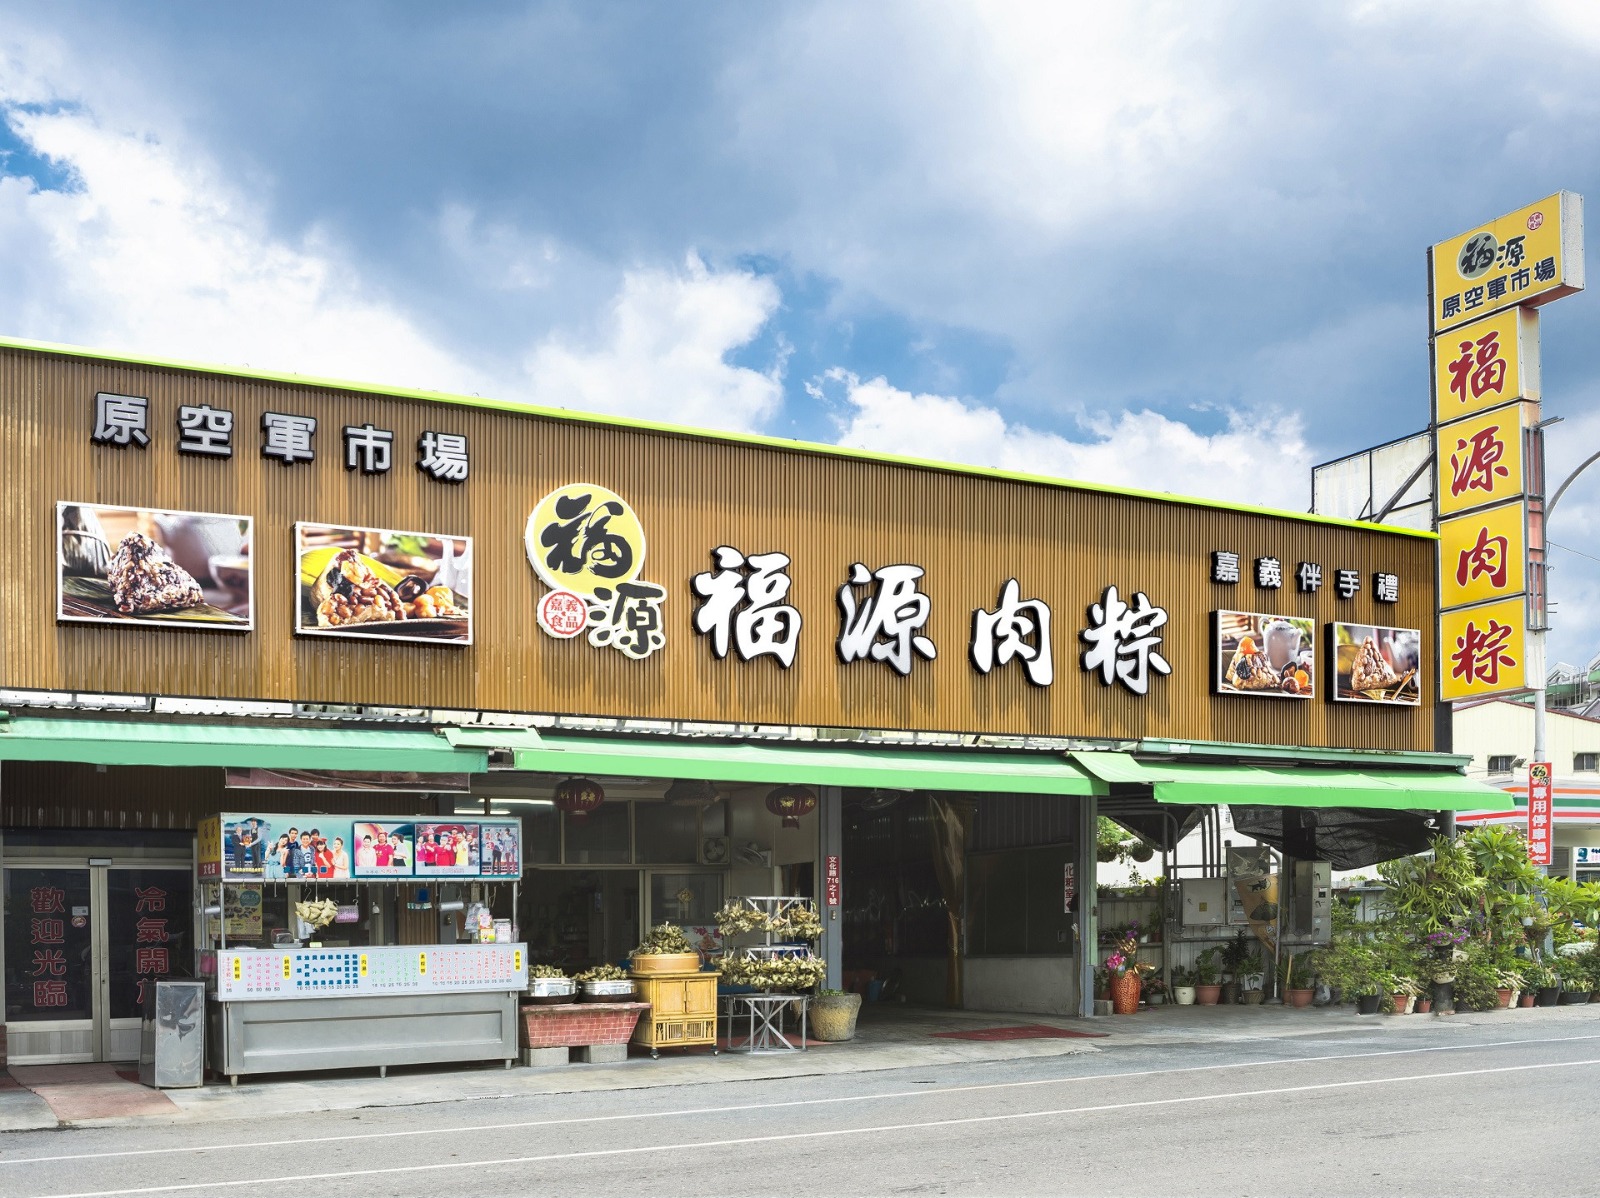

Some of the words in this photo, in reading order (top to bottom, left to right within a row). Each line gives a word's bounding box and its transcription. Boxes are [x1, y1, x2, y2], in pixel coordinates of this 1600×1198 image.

[1442, 256, 1556, 320] 原空軍市場
[1460, 235, 1526, 274] 福源
[91, 391, 470, 482] 原空軍市場
[1448, 331, 1516, 686] 福源肉粽
[690, 544, 1172, 696] 福源肉粽
[1211, 550, 1399, 604] 嘉義伴手禮
[827, 856, 839, 905] 文化路716之1號
[30, 886, 68, 1007] 歡迎光臨
[135, 887, 169, 1004] 冷氣開
